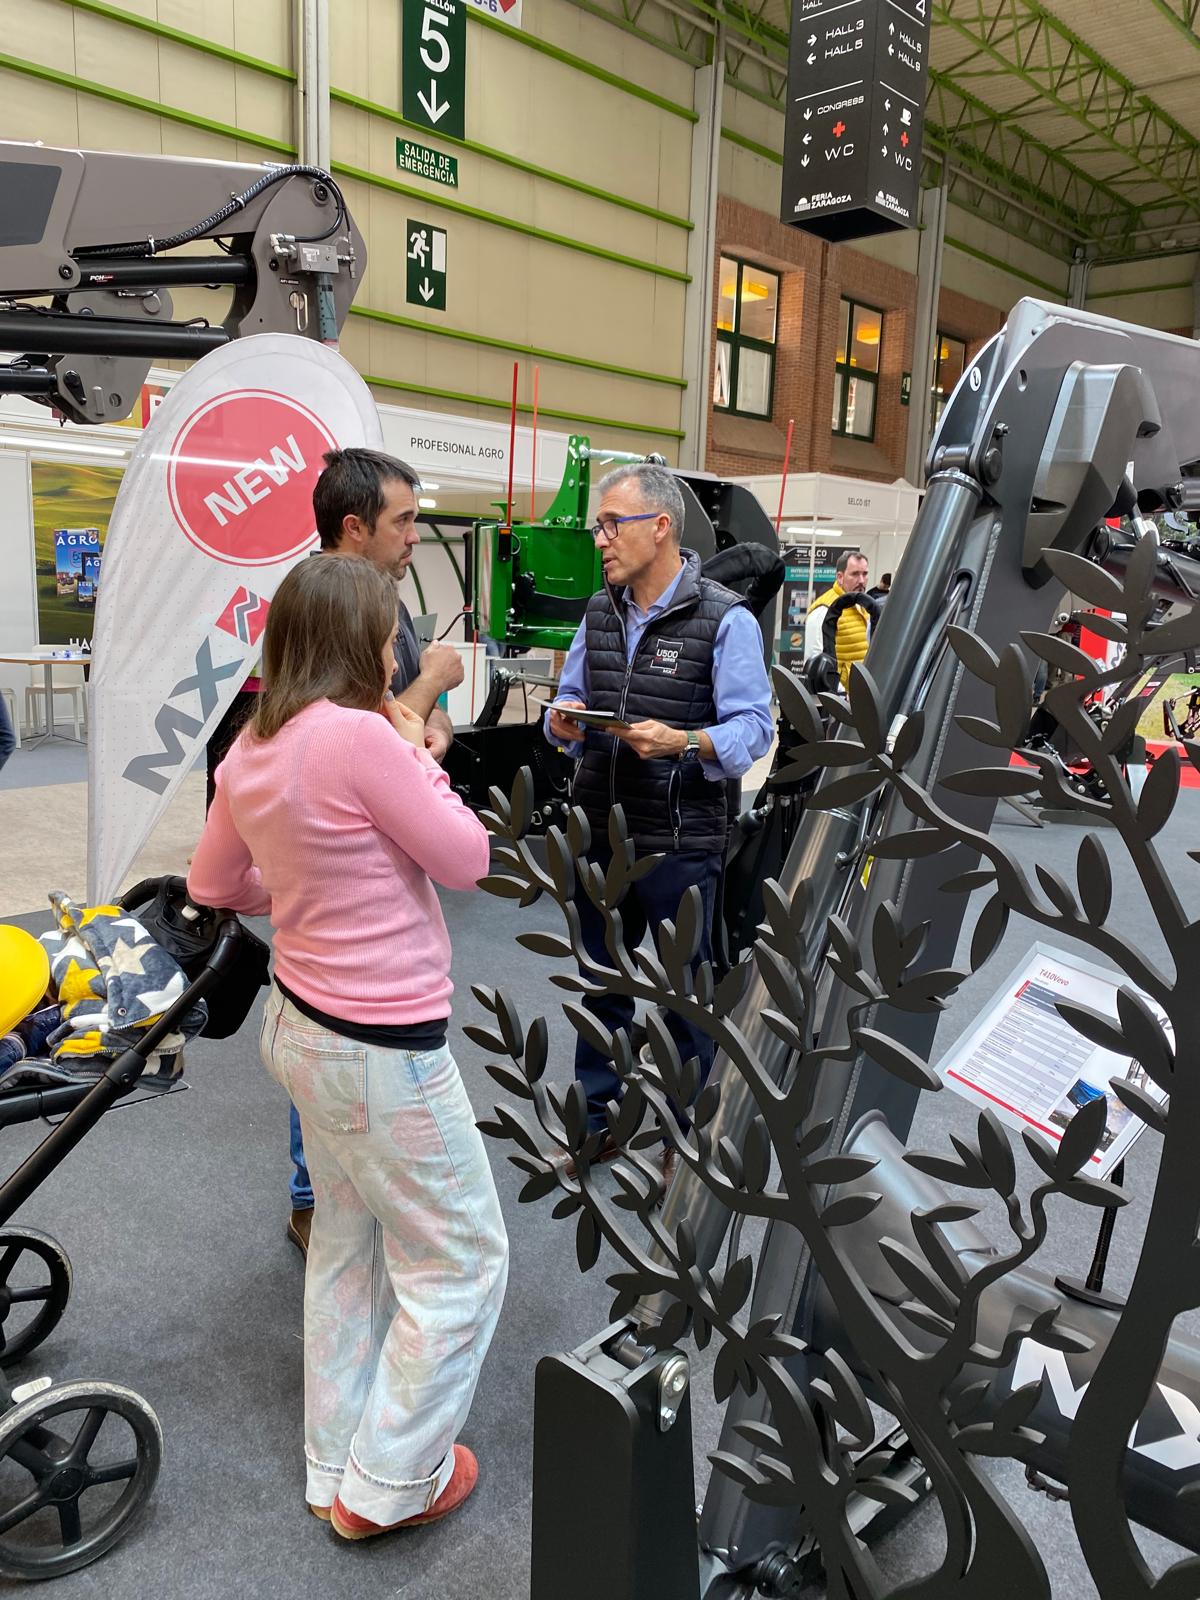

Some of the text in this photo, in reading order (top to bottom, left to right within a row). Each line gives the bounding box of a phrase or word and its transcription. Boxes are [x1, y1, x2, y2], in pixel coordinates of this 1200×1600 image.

[915, 0, 926, 18] 4
[825, 19, 865, 41] HALL 3
[419, 7, 451, 73] 5
[900, 31, 916, 50] HALL
[824, 42, 854, 59] HALL
[898, 50, 915, 69] HALL
[817, 95, 865, 115] CONGRESS
[404, 143, 450, 171] SALIDA DE
[824, 143, 855, 161] WC
[894, 151, 913, 171] WC
[399, 154, 455, 184] EMERGENCIA
[811, 191, 833, 203] FERIA
[811, 194, 853, 209] ZARAGOZA
[885, 193, 899, 206] FERIA
[885, 201, 910, 218] ZARAGOZA
[410, 437, 505, 460] PROFESIONAL AGRO
[203, 434, 308, 527] NEW
[657, 649, 678, 658] U500
[122, 635, 245, 796] MX
